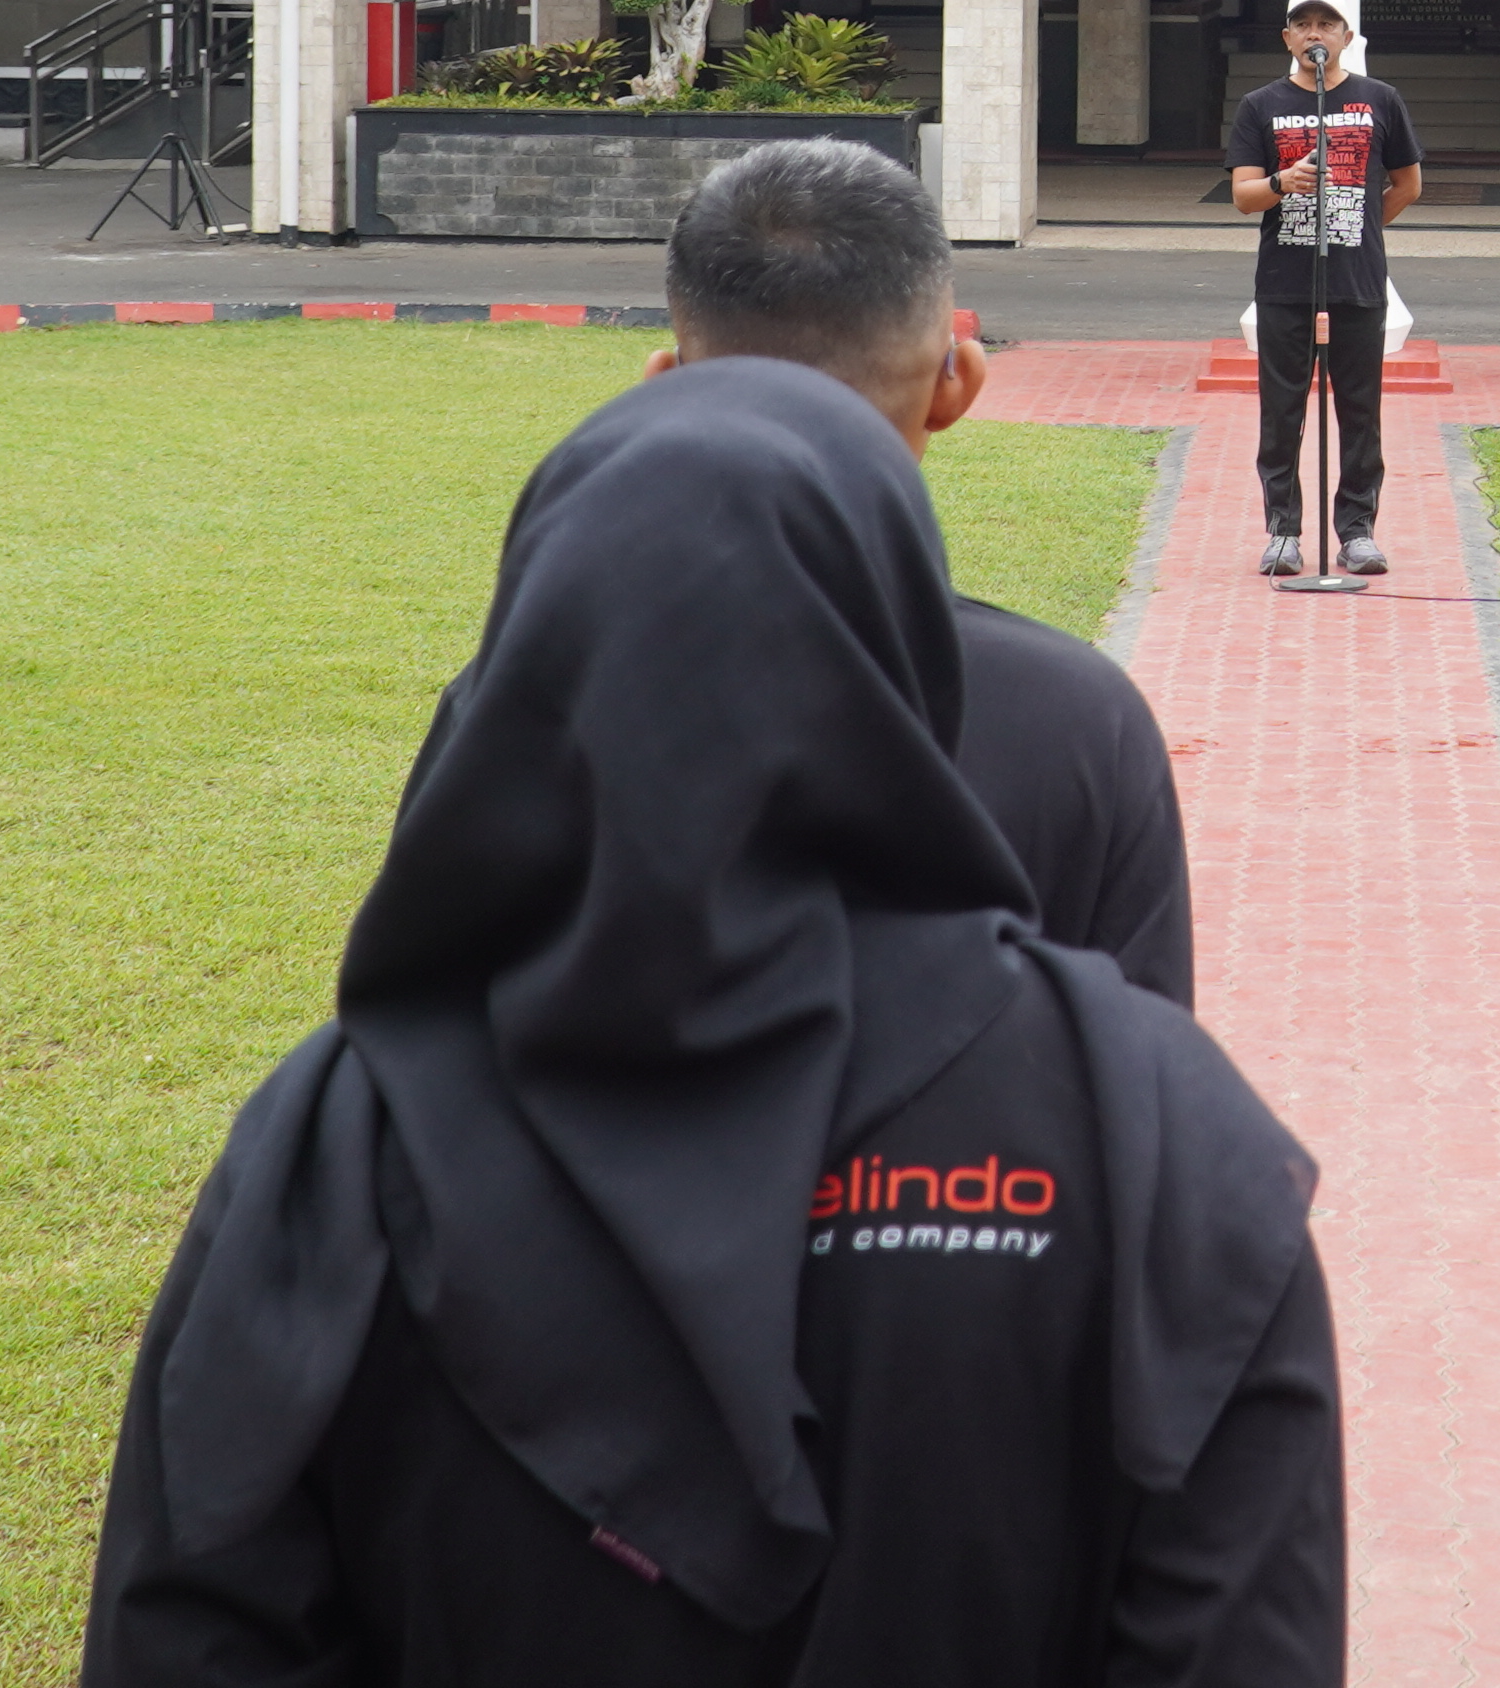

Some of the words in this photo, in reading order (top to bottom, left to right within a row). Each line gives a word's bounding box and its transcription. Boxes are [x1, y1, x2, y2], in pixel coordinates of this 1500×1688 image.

[1343, 102, 1373, 114] KITA
[1273, 112, 1374, 130] INDONESIA
[1327, 152, 1356, 165] BATAK
[1326, 196, 1356, 210] ASMAT
[852, 1223, 1054, 1258] company
